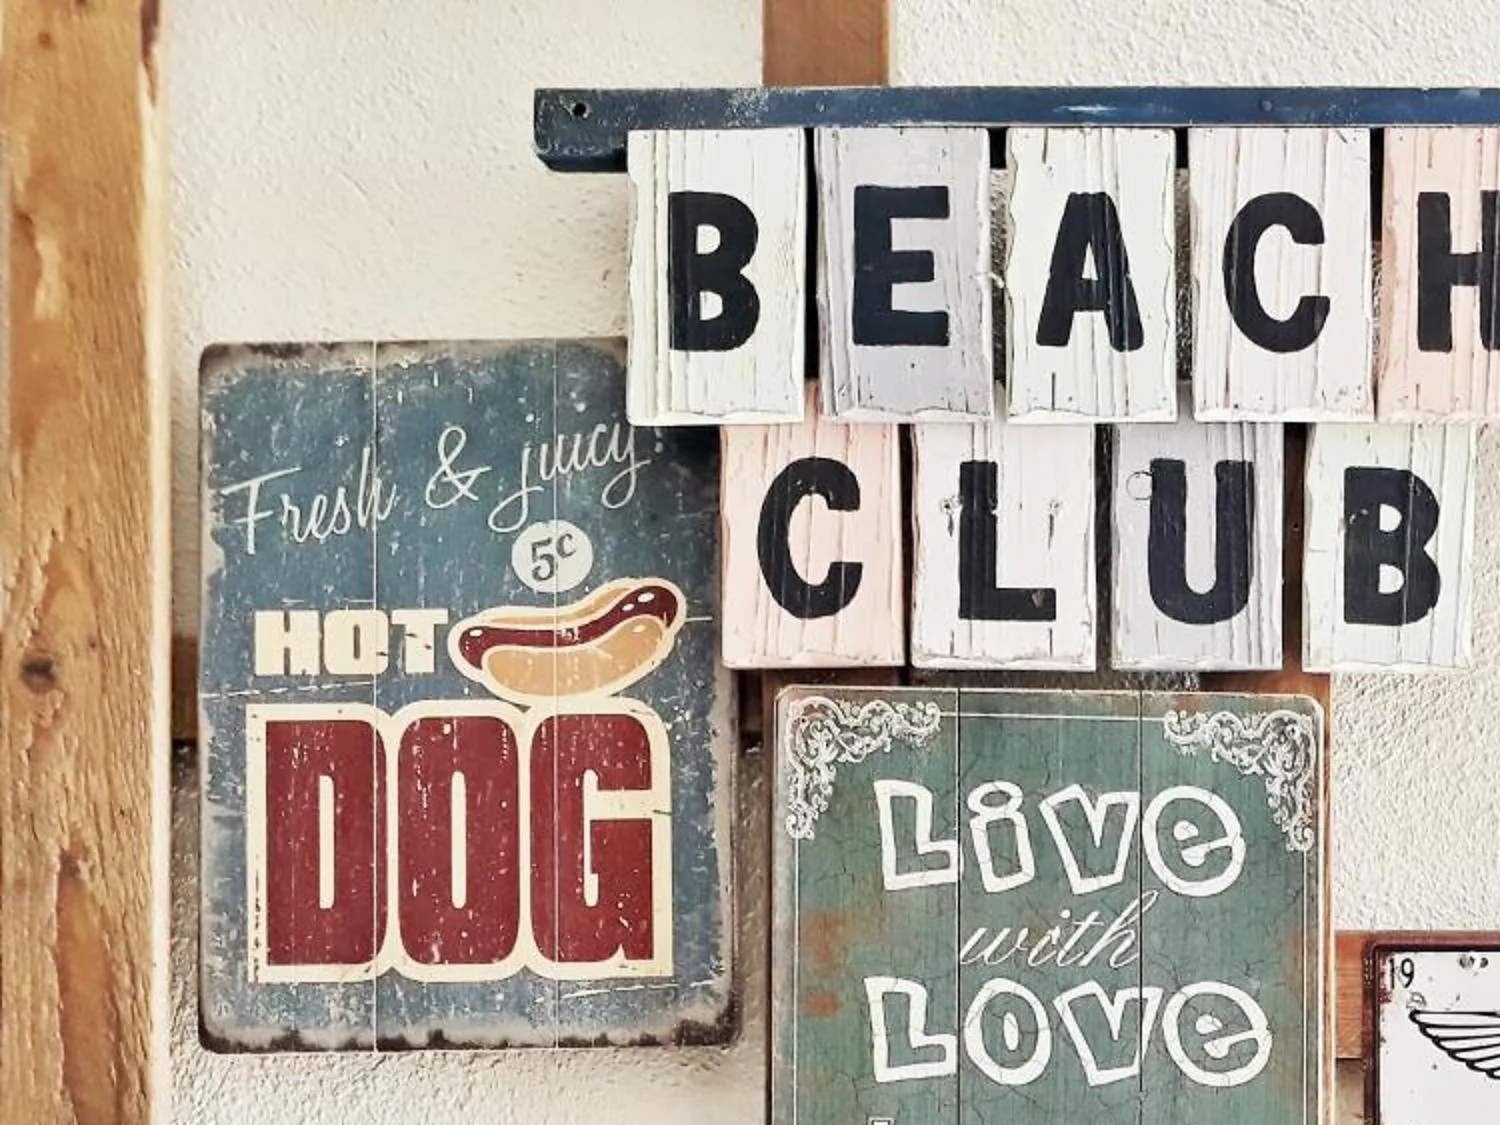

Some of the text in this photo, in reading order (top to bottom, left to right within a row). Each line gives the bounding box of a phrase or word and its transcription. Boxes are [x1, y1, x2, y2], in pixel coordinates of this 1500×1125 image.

[221, 442, 398, 555] Fresh
[425, 426, 493, 510] &
[756, 456, 1443, 626] CLUB
[254, 608, 449, 677] HOT
[247, 701, 674, 982] DOG
[873, 779, 1246, 897] Live
[959, 890, 1159, 968] with
[1388, 958, 1415, 990] 19
[863, 975, 1273, 1088] Love
